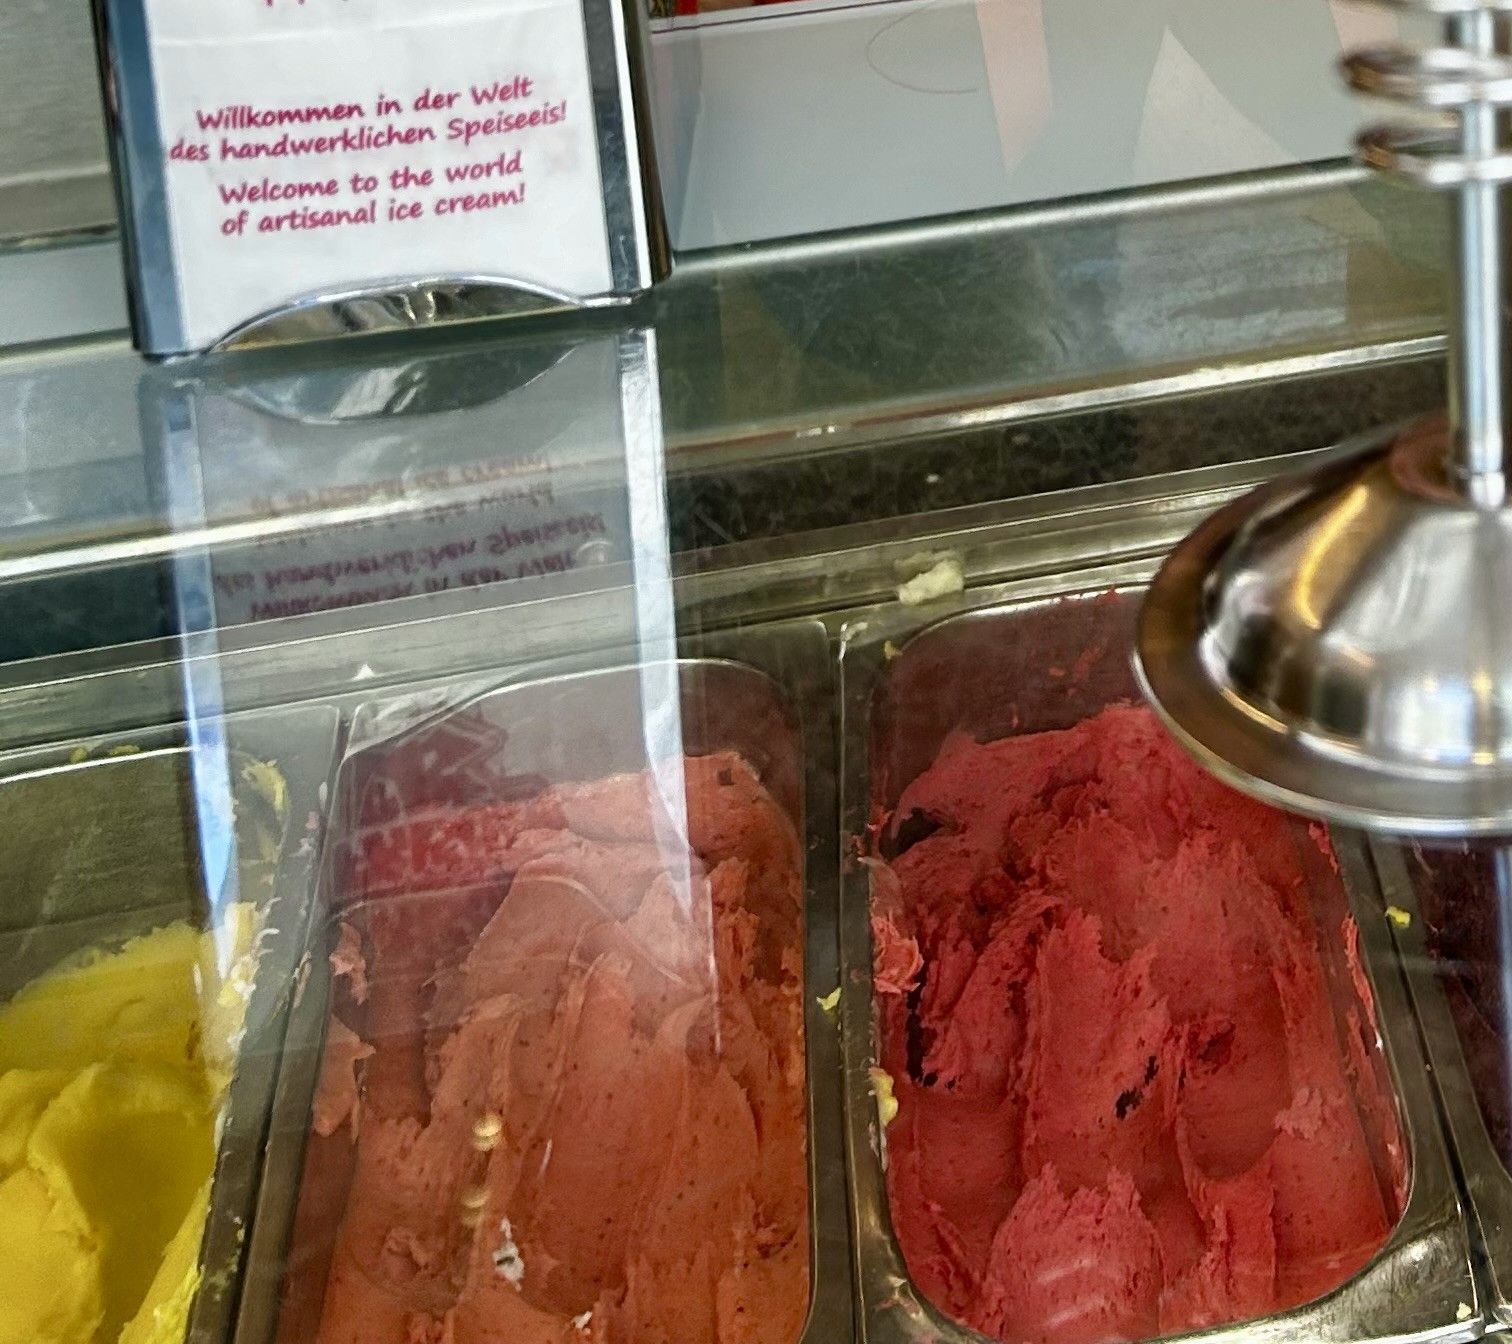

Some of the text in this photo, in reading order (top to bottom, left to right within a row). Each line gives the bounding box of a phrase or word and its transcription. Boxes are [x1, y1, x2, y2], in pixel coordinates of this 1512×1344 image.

[197, 75, 533, 130] Willkommen in der Welt
[170, 101, 567, 162] des handwerklichen Speiseeis!
[219, 150, 523, 205] Welcome to the world
[221, 182, 526, 236] of artisanal ice cream!
